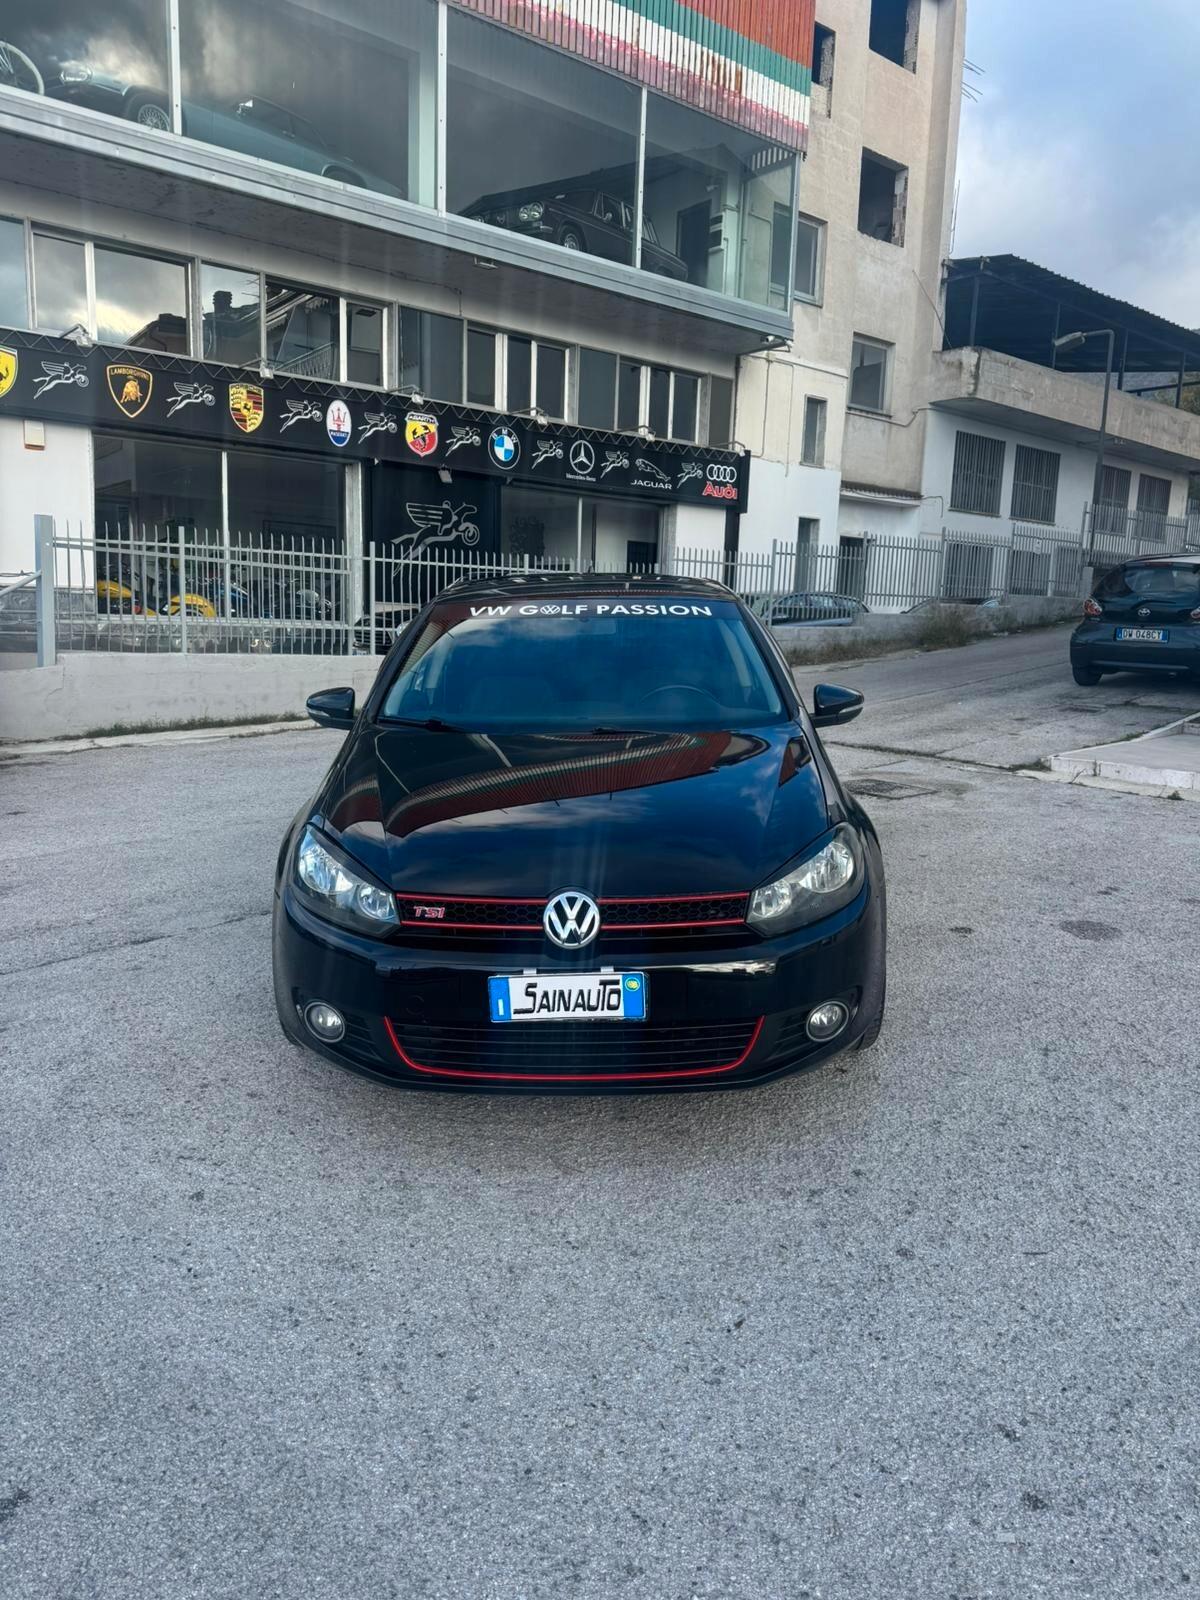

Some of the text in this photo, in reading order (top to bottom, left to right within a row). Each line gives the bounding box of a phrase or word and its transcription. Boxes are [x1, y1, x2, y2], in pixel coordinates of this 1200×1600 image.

[491, 427, 519, 443] BMW
[630, 479, 673, 489] JAGUAR
[469, 603, 713, 617] VW GOLF PASSION
[413, 905, 445, 919] TSI
[545, 892, 600, 948] VW
